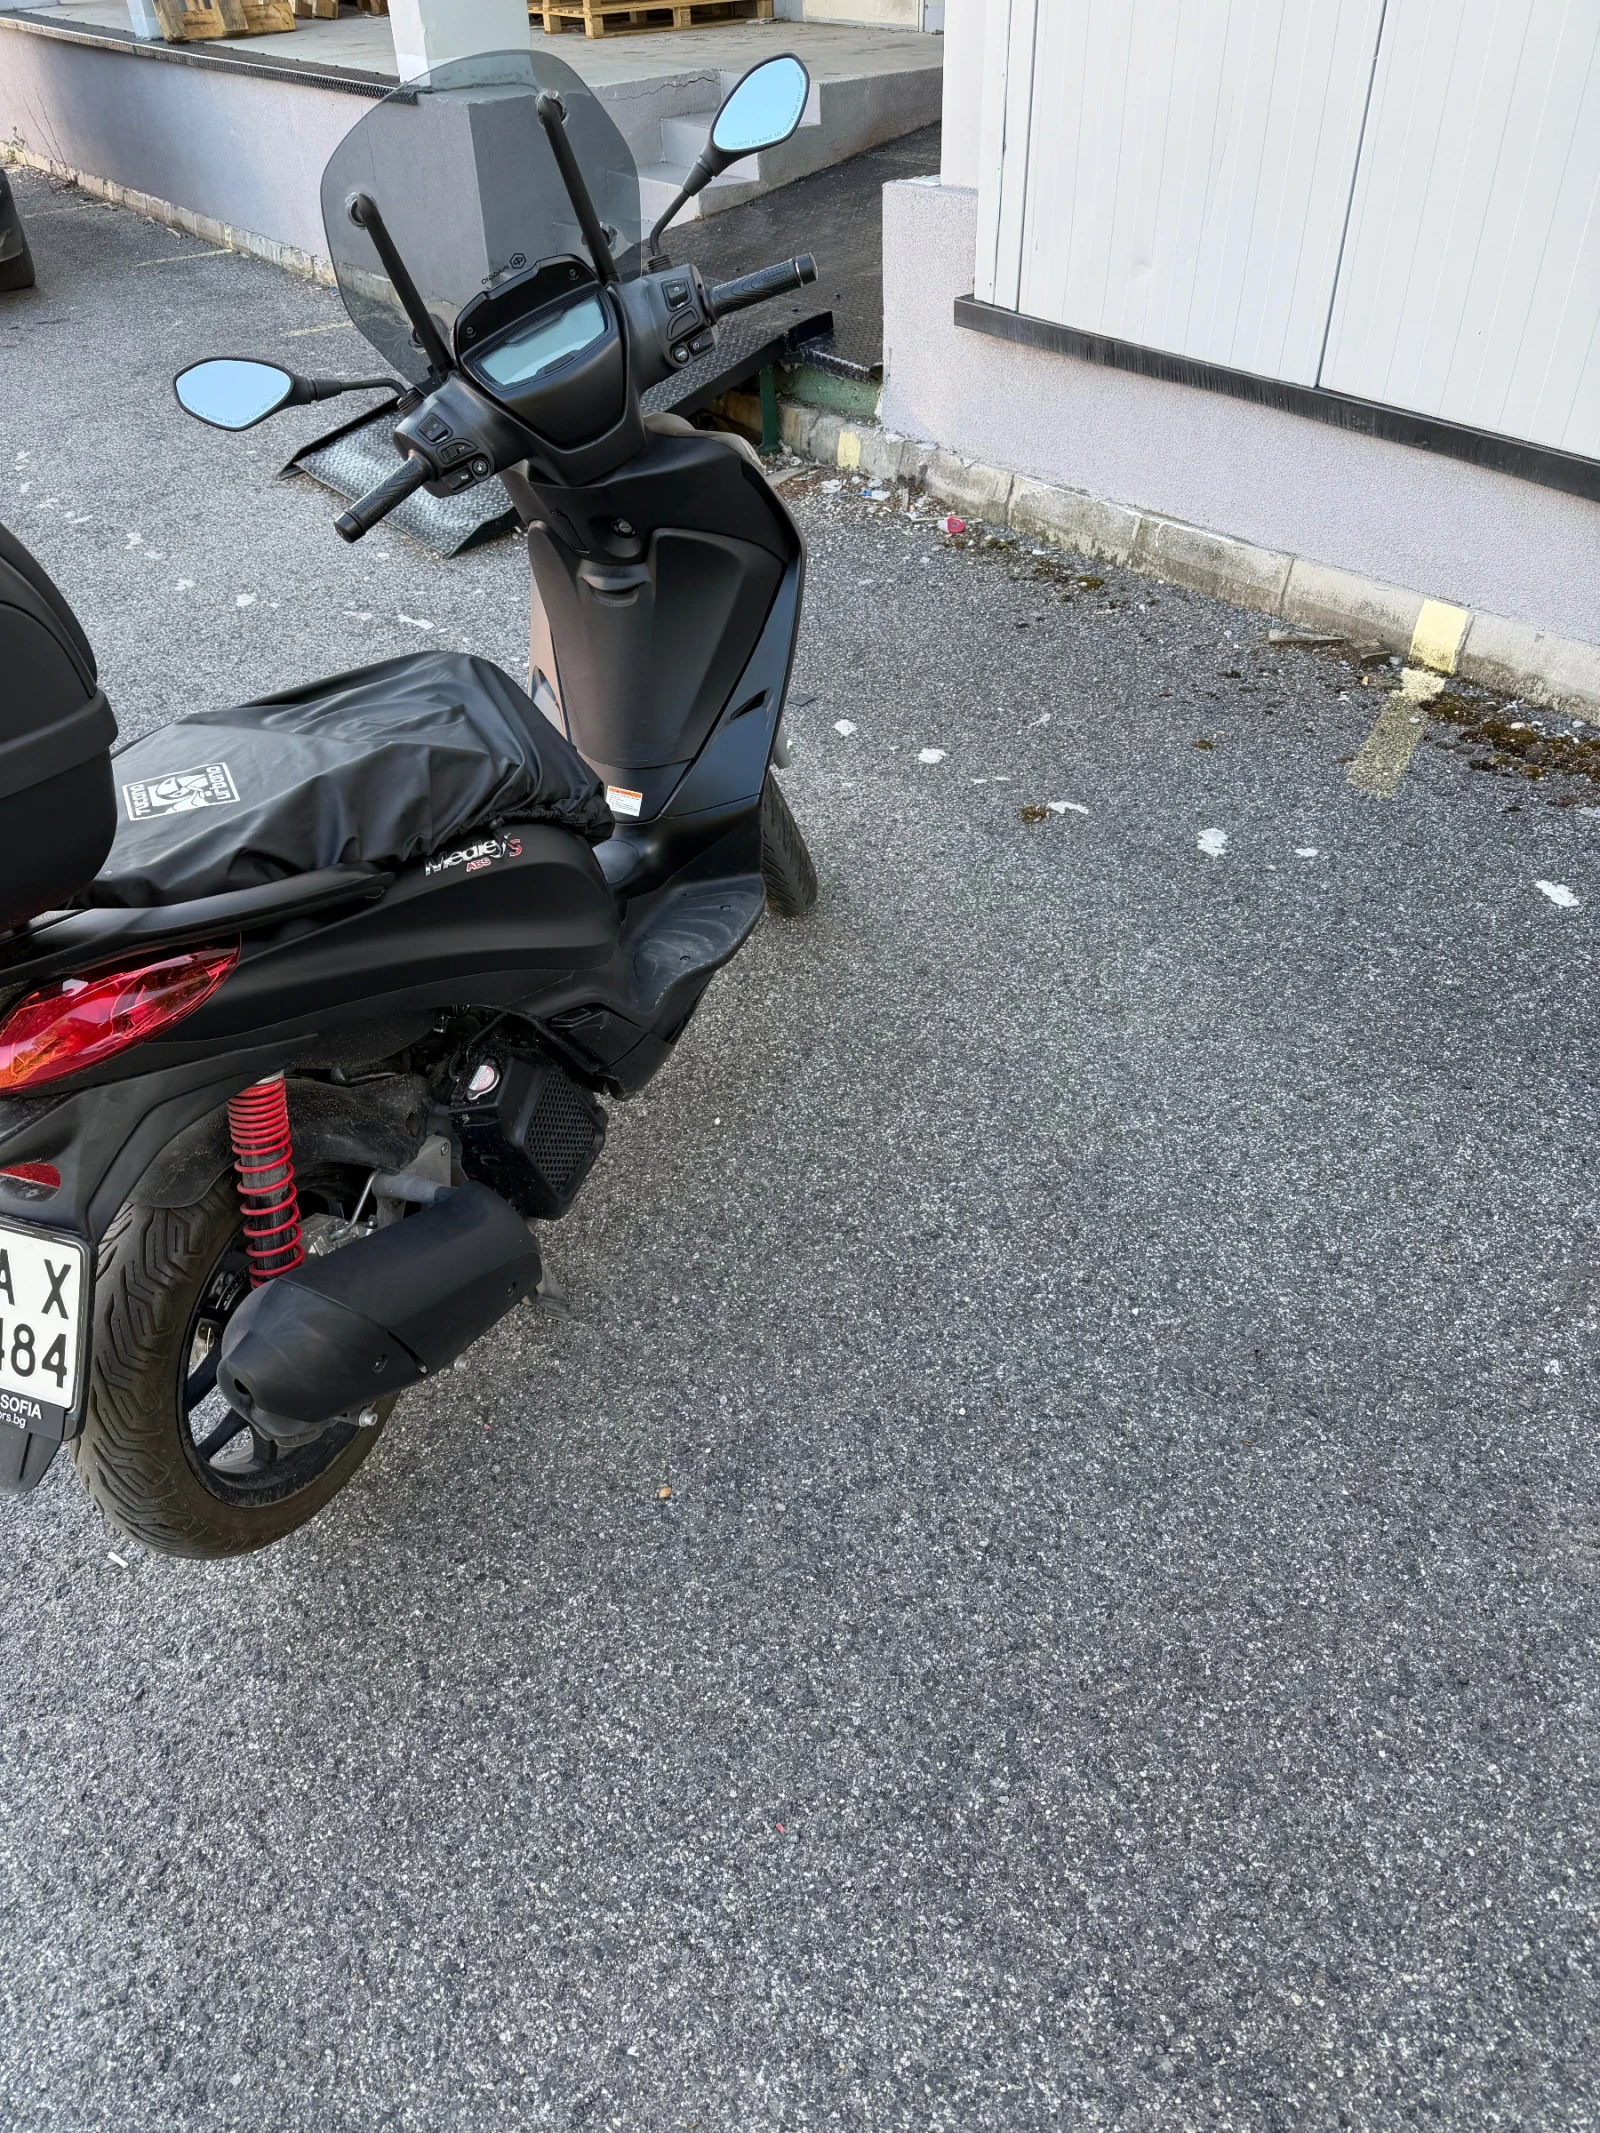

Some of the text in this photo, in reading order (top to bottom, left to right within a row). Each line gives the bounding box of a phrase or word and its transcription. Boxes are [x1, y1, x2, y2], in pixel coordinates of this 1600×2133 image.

[466, 857, 492, 872] ABS
[41, 1258, 72, 1320] X
[0, 1317, 68, 1389] 84
[0, 1394, 42, 1420] SOFIA
